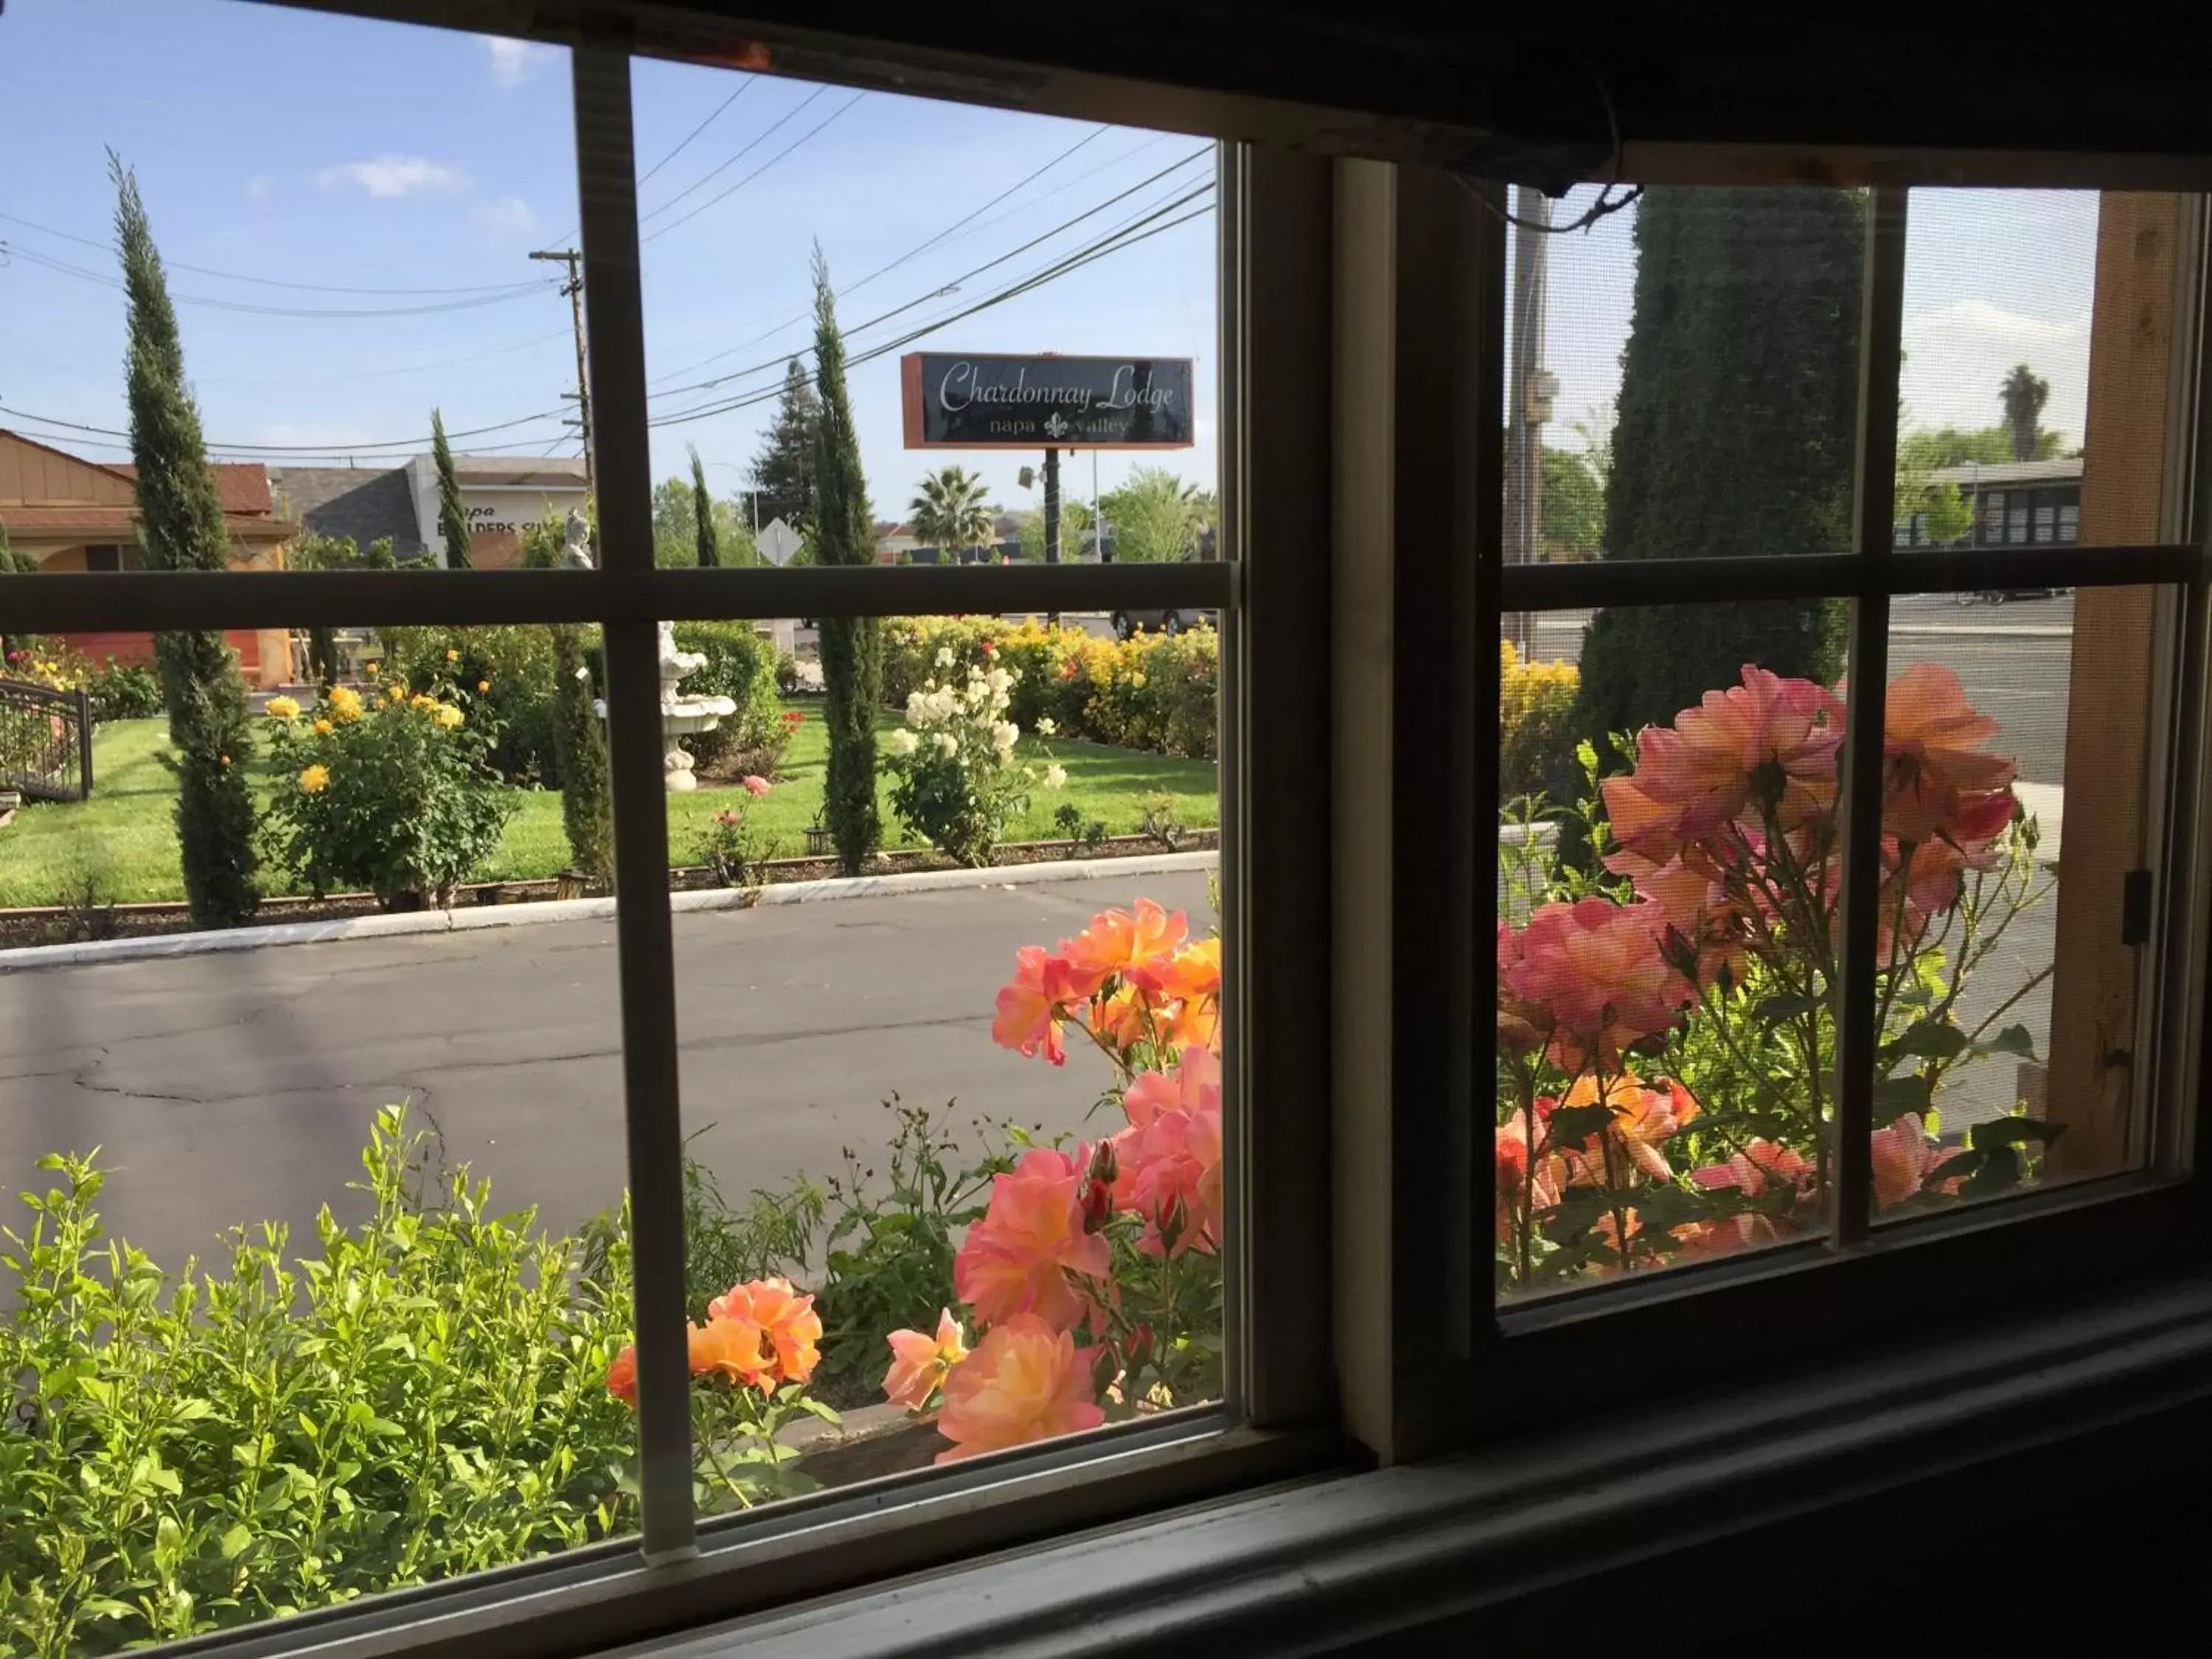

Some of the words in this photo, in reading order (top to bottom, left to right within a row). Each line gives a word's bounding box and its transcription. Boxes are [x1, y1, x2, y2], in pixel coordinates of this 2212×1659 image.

[940, 362, 1092, 413] Chardonnay
[1096, 366, 1174, 414] Lodge
[990, 418, 1035, 436] napa
[1076, 417, 1130, 436] valley
